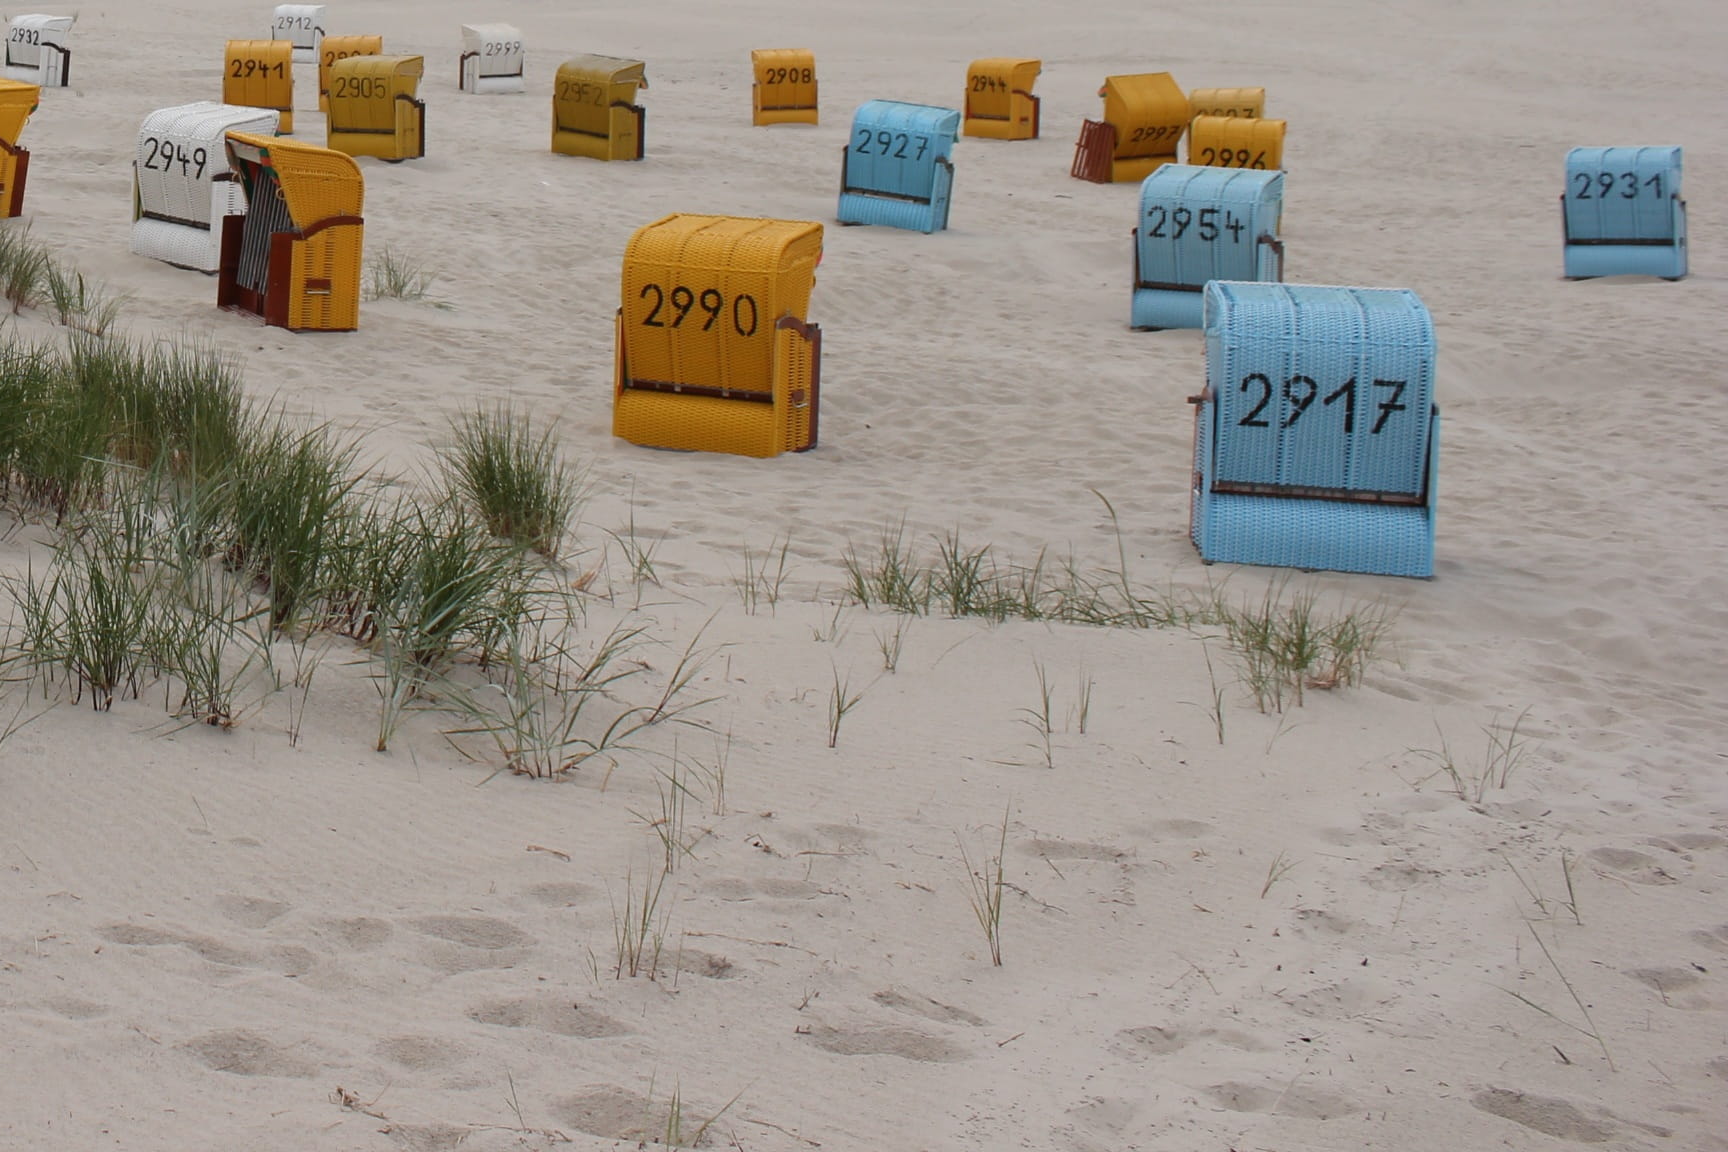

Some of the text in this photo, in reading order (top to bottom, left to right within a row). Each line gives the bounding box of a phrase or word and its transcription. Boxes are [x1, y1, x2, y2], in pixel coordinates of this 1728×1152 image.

[278, 17, 311, 30] 2912
[11, 28, 40, 45] 2932
[485, 41, 520, 56] 2999
[231, 59, 284, 80] 2941
[767, 68, 811, 84] 2908
[335, 77, 386, 99] 2905
[972, 75, 1007, 93] 2944
[856, 129, 928, 161] 2927
[1132, 126, 1179, 143] 2997
[144, 137, 208, 180] 2949
[1201, 147, 1266, 169] 2996
[1575, 173, 1663, 199] 2931
[1147, 206, 1246, 243] 2954
[641, 284, 759, 337] 2990
[1239, 373, 1405, 434] 2917
